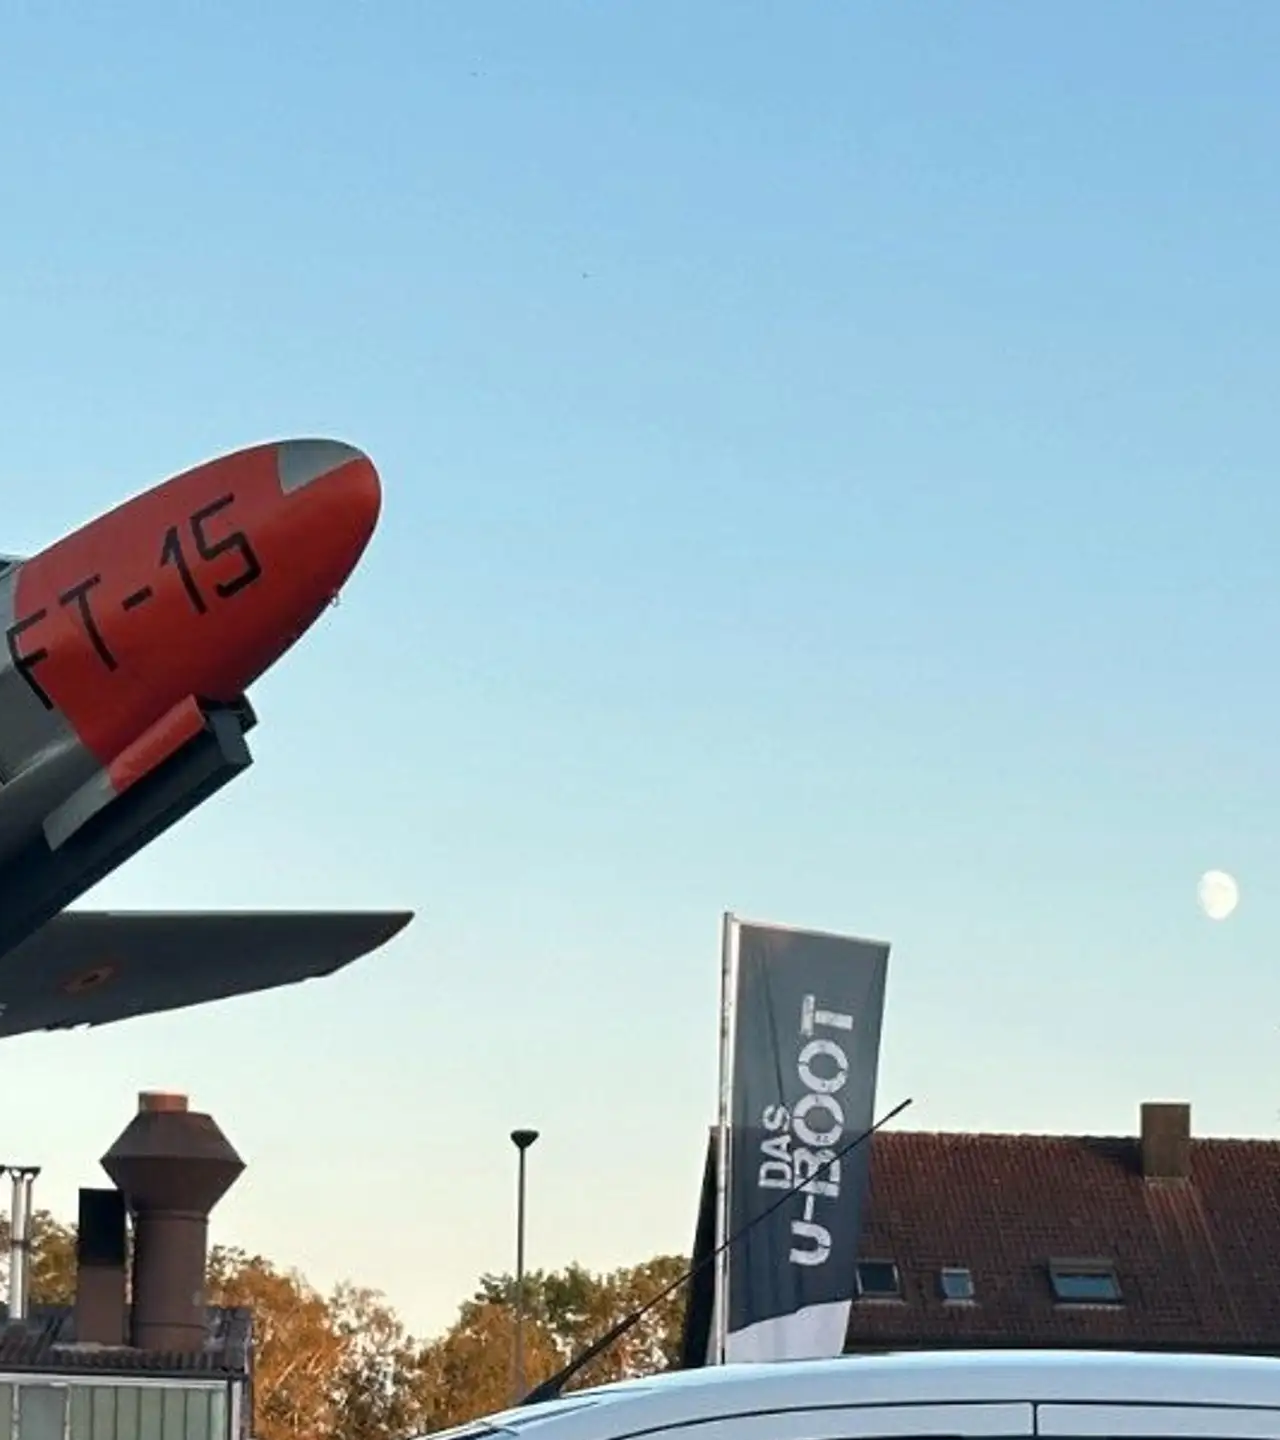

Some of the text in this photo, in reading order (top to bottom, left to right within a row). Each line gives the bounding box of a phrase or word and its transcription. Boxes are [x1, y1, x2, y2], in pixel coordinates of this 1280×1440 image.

[6, 493, 263, 710] FT-15
[759, 1103, 792, 1189] DAS
[788, 994, 854, 1267] U-BOOT
